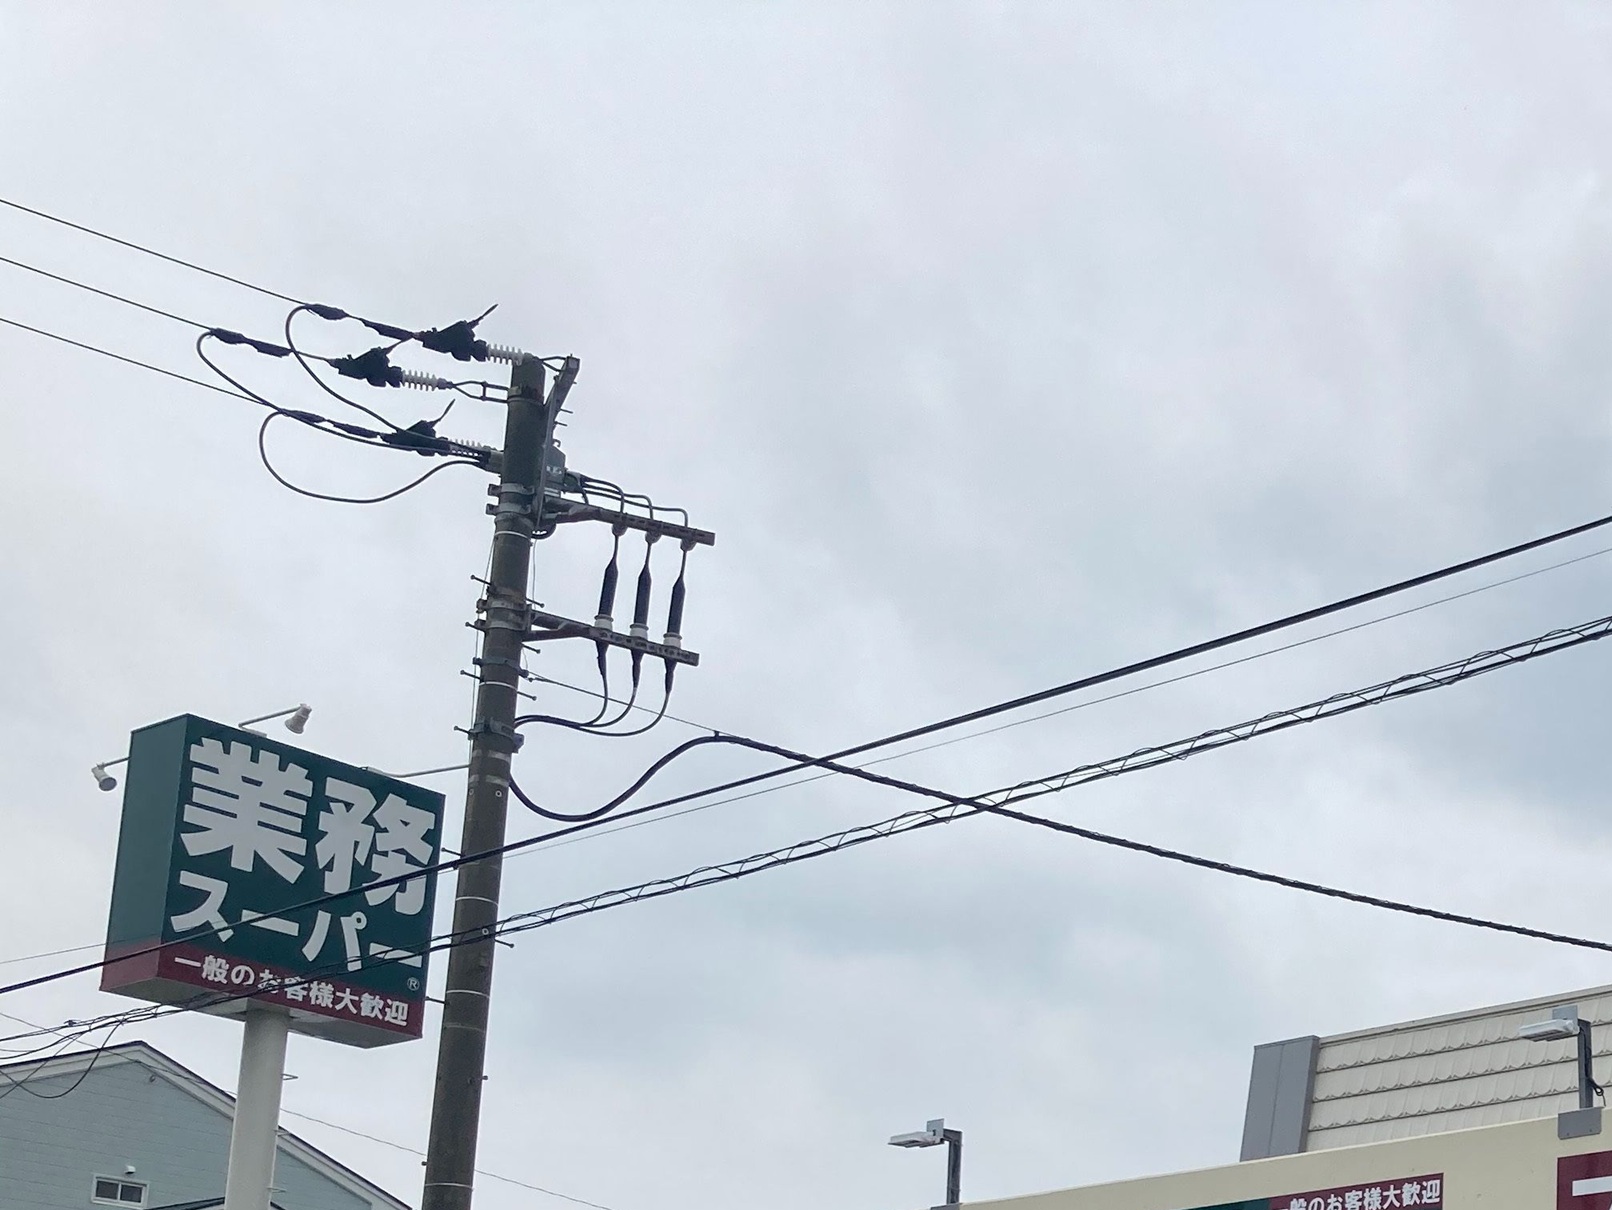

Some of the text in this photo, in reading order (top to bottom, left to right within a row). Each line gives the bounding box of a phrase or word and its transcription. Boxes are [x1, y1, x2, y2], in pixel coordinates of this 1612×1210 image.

[180, 737, 436, 915] 業務
[170, 870, 422, 971] スーパー
[174, 954, 409, 1027] 一般のお客様大歓迎
